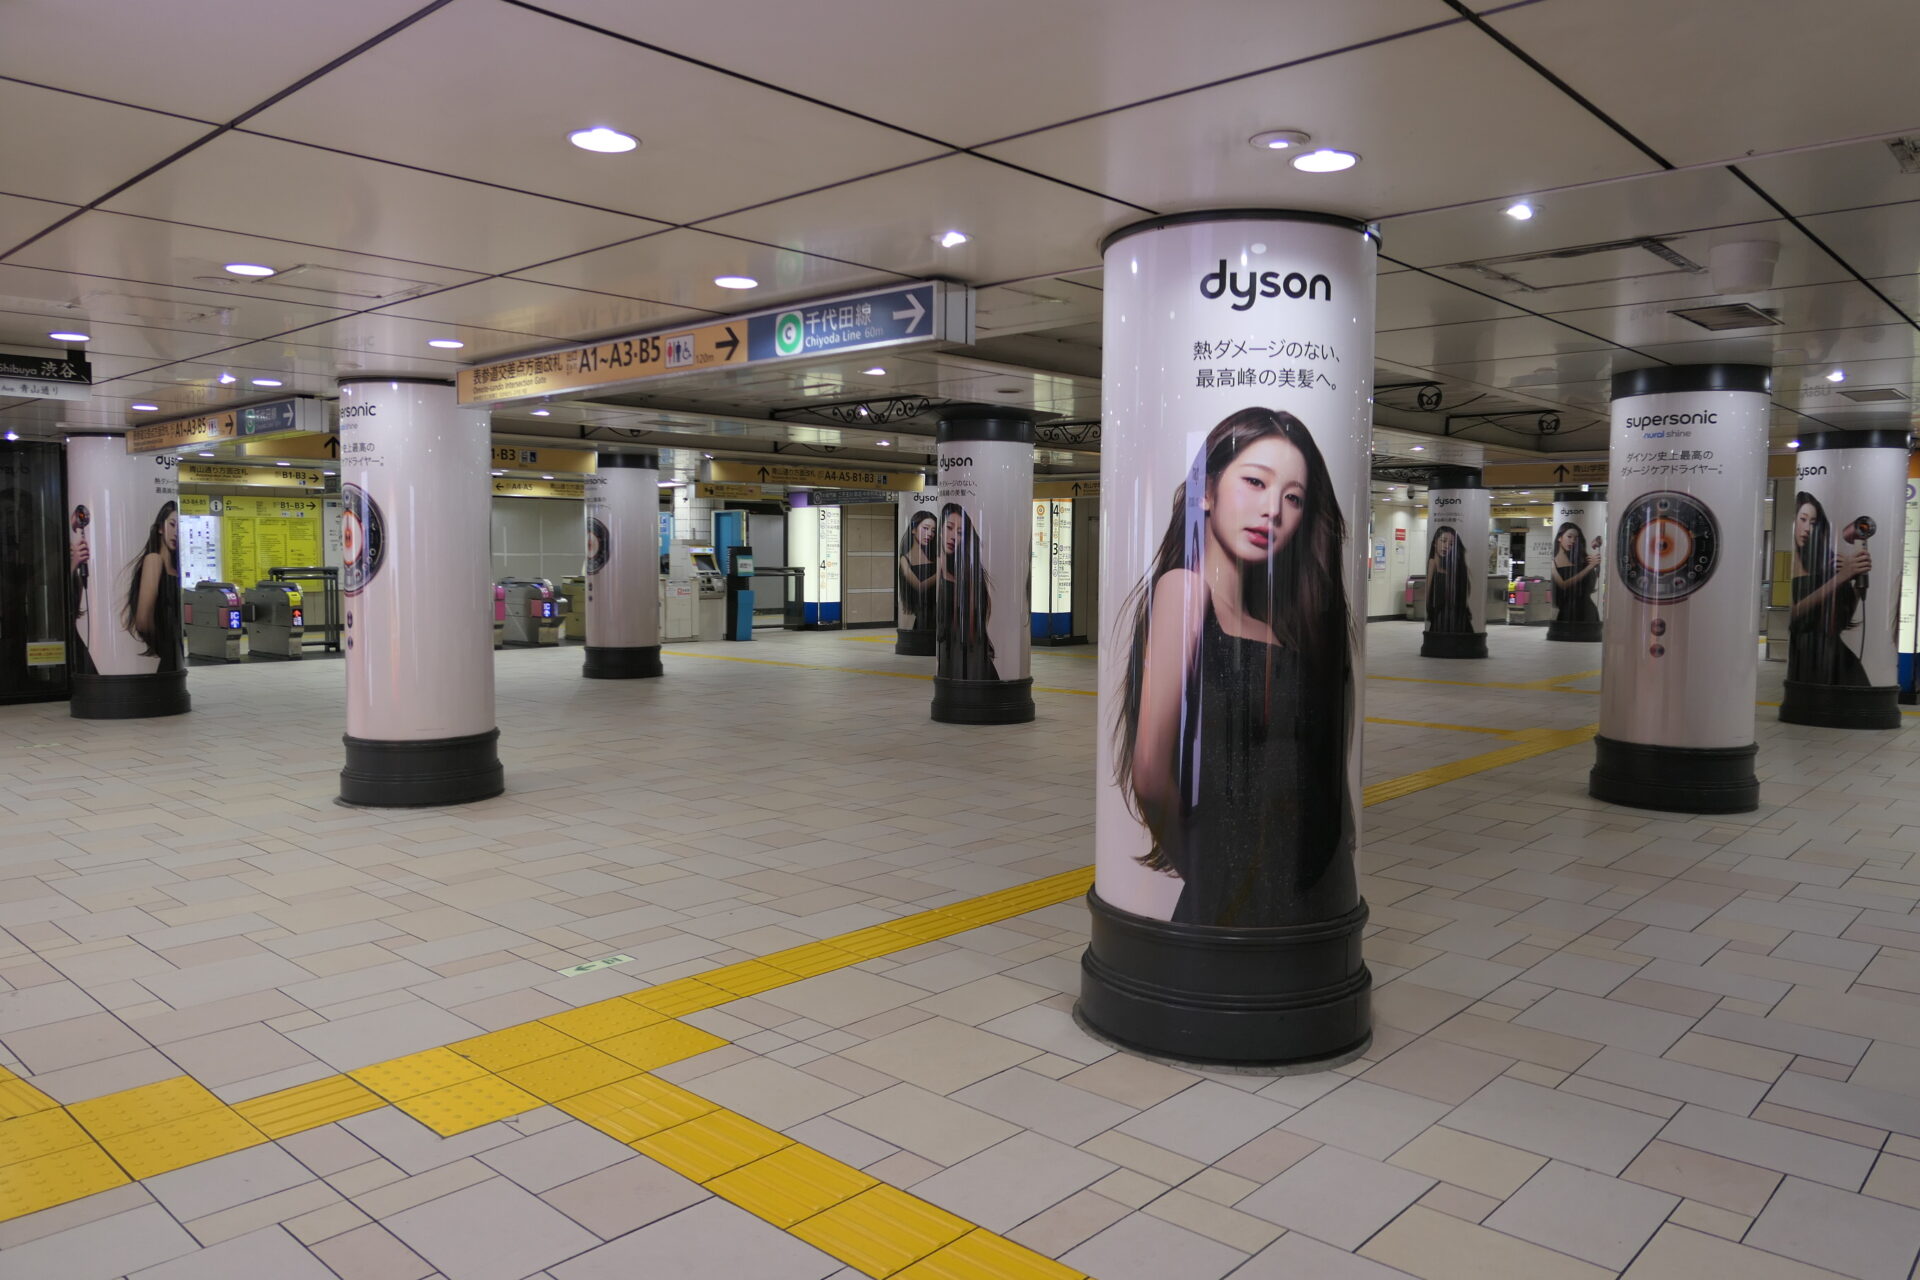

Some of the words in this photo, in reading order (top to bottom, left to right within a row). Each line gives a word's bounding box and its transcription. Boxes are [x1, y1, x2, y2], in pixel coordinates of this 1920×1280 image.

[1200, 259, 1331, 311] dyson
[805, 303, 872, 334] 千代田線
[805, 333, 840, 349] Chiyoda
[842, 329, 861, 342] Line
[864, 327, 884, 338] 60m
[1193, 339, 1340, 362] 熱ダメージのない、
[41, 361, 77, 378] 渋谷
[473, 355, 563, 385] 表参道交差点方面改札
[1196, 368, 1336, 390] 最高峰の美髪へ。
[1626, 410, 1718, 430] supersonic
[1642, 430, 1665, 439] nural
[1666, 429, 1692, 438] shine
[940, 454, 973, 471] dyson
[1627, 450, 1713, 462] ダイソン史上最高の
[1434, 497, 1462, 508] dyson
[820, 510, 826, 521] 3
[1053, 504, 1059, 517] 4
[1560, 507, 1585, 517] dyson
[1053, 543, 1059, 555] 3
[820, 560, 826, 570] 4
[230, 611, 240, 619] IC
